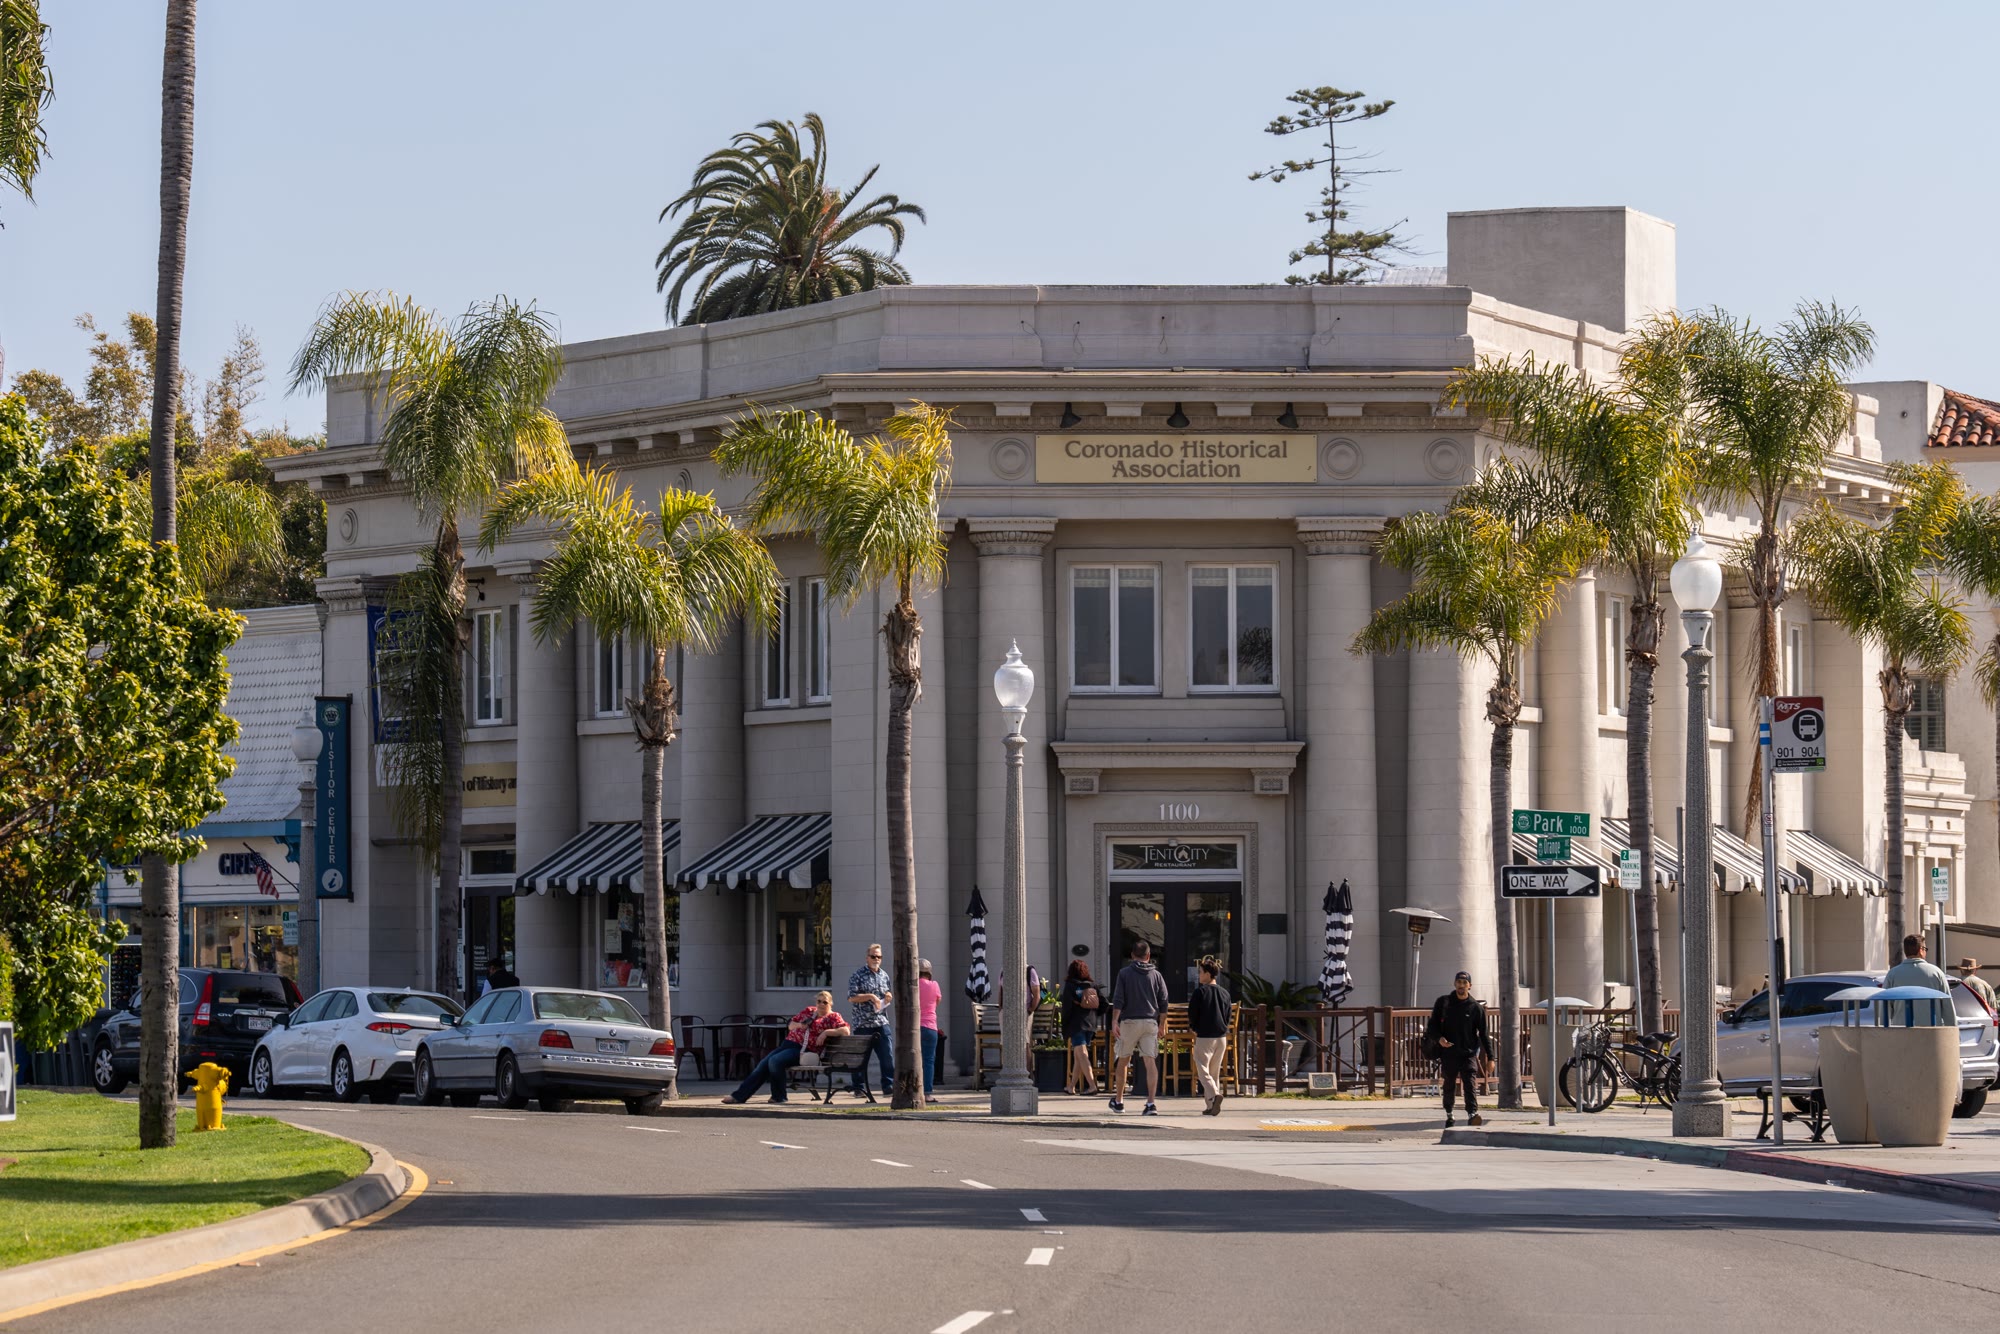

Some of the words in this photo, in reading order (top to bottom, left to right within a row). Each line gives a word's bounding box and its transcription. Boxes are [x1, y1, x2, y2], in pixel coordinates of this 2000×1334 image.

[1064, 440, 1174, 459] Coronado
[1181, 440, 1288, 459] Historical
[1111, 459, 1241, 478] Association
[1777, 702, 1801, 710] MTS
[1777, 747, 1795, 758] 901
[1801, 746, 1820, 758] 904
[327, 731, 336, 799] VISITOR
[1159, 803, 1200, 821] 1100
[1533, 813, 1564, 833] Park
[1574, 814, 1583, 824] PL
[327, 806, 336, 864] CENTER
[1569, 825, 1587, 835] 1000
[1543, 838, 1561, 860] Orange
[1622, 850, 1628, 860] 2
[1621, 862, 1640, 870] PARKING
[1933, 868, 1938, 877] 2
[1510, 875, 1537, 888] ONE
[1542, 875, 1569, 888] WAY
